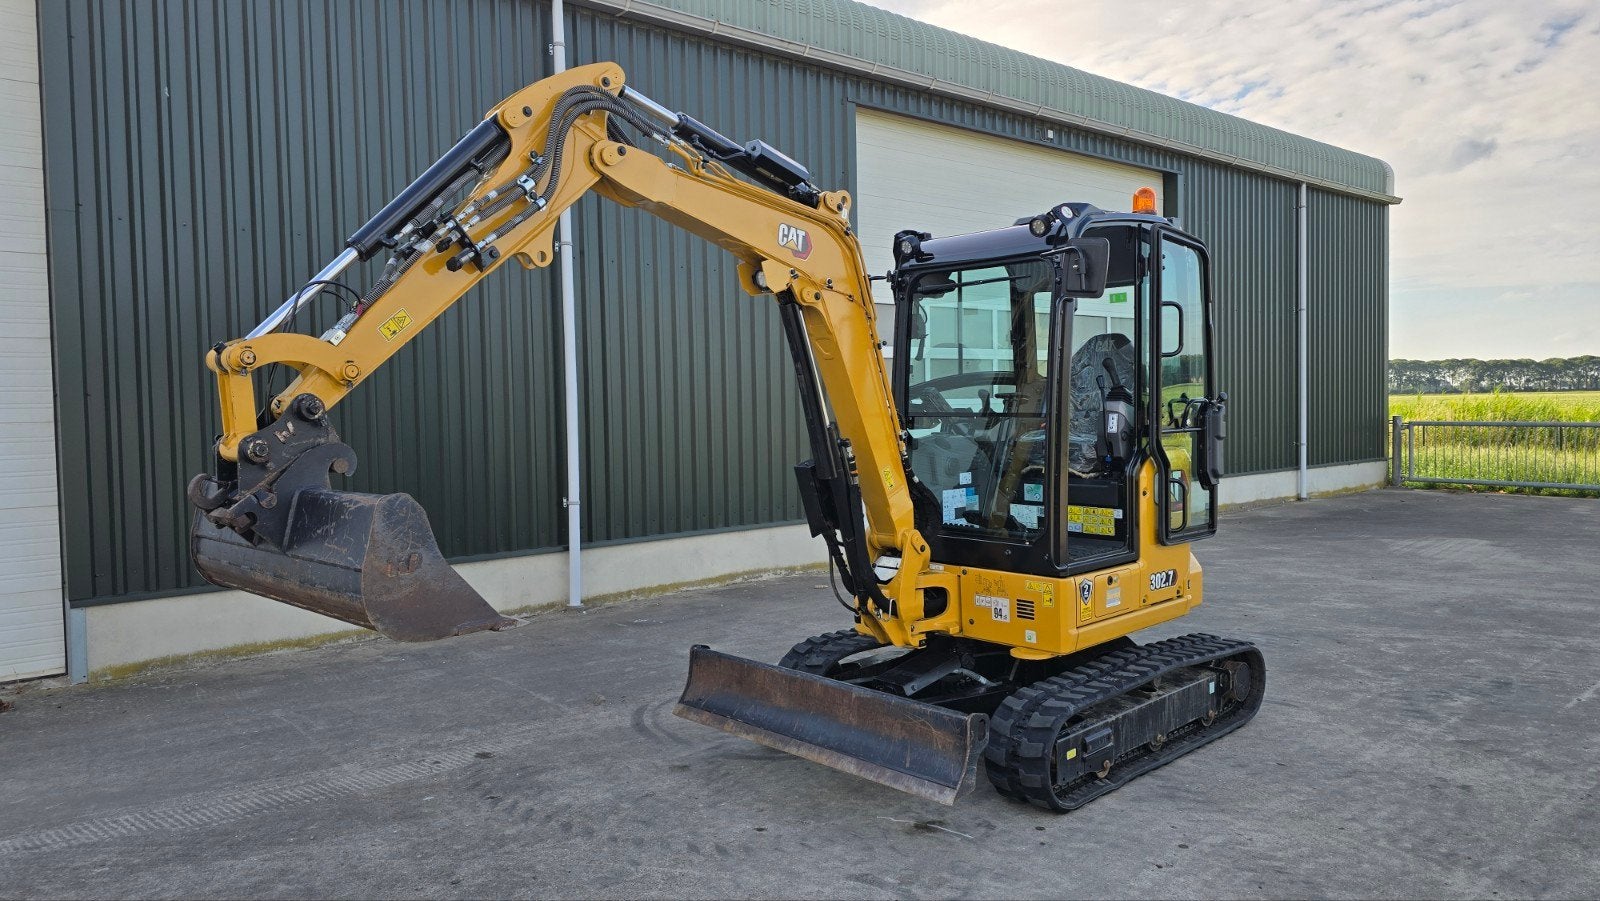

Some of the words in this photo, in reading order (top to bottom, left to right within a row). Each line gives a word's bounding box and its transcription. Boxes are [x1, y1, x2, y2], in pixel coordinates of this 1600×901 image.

[778, 223, 806, 252] CAT
[1150, 570, 1174, 590] 302.7
[1083, 584, 1089, 595] 2
[993, 607, 1003, 620] 94
